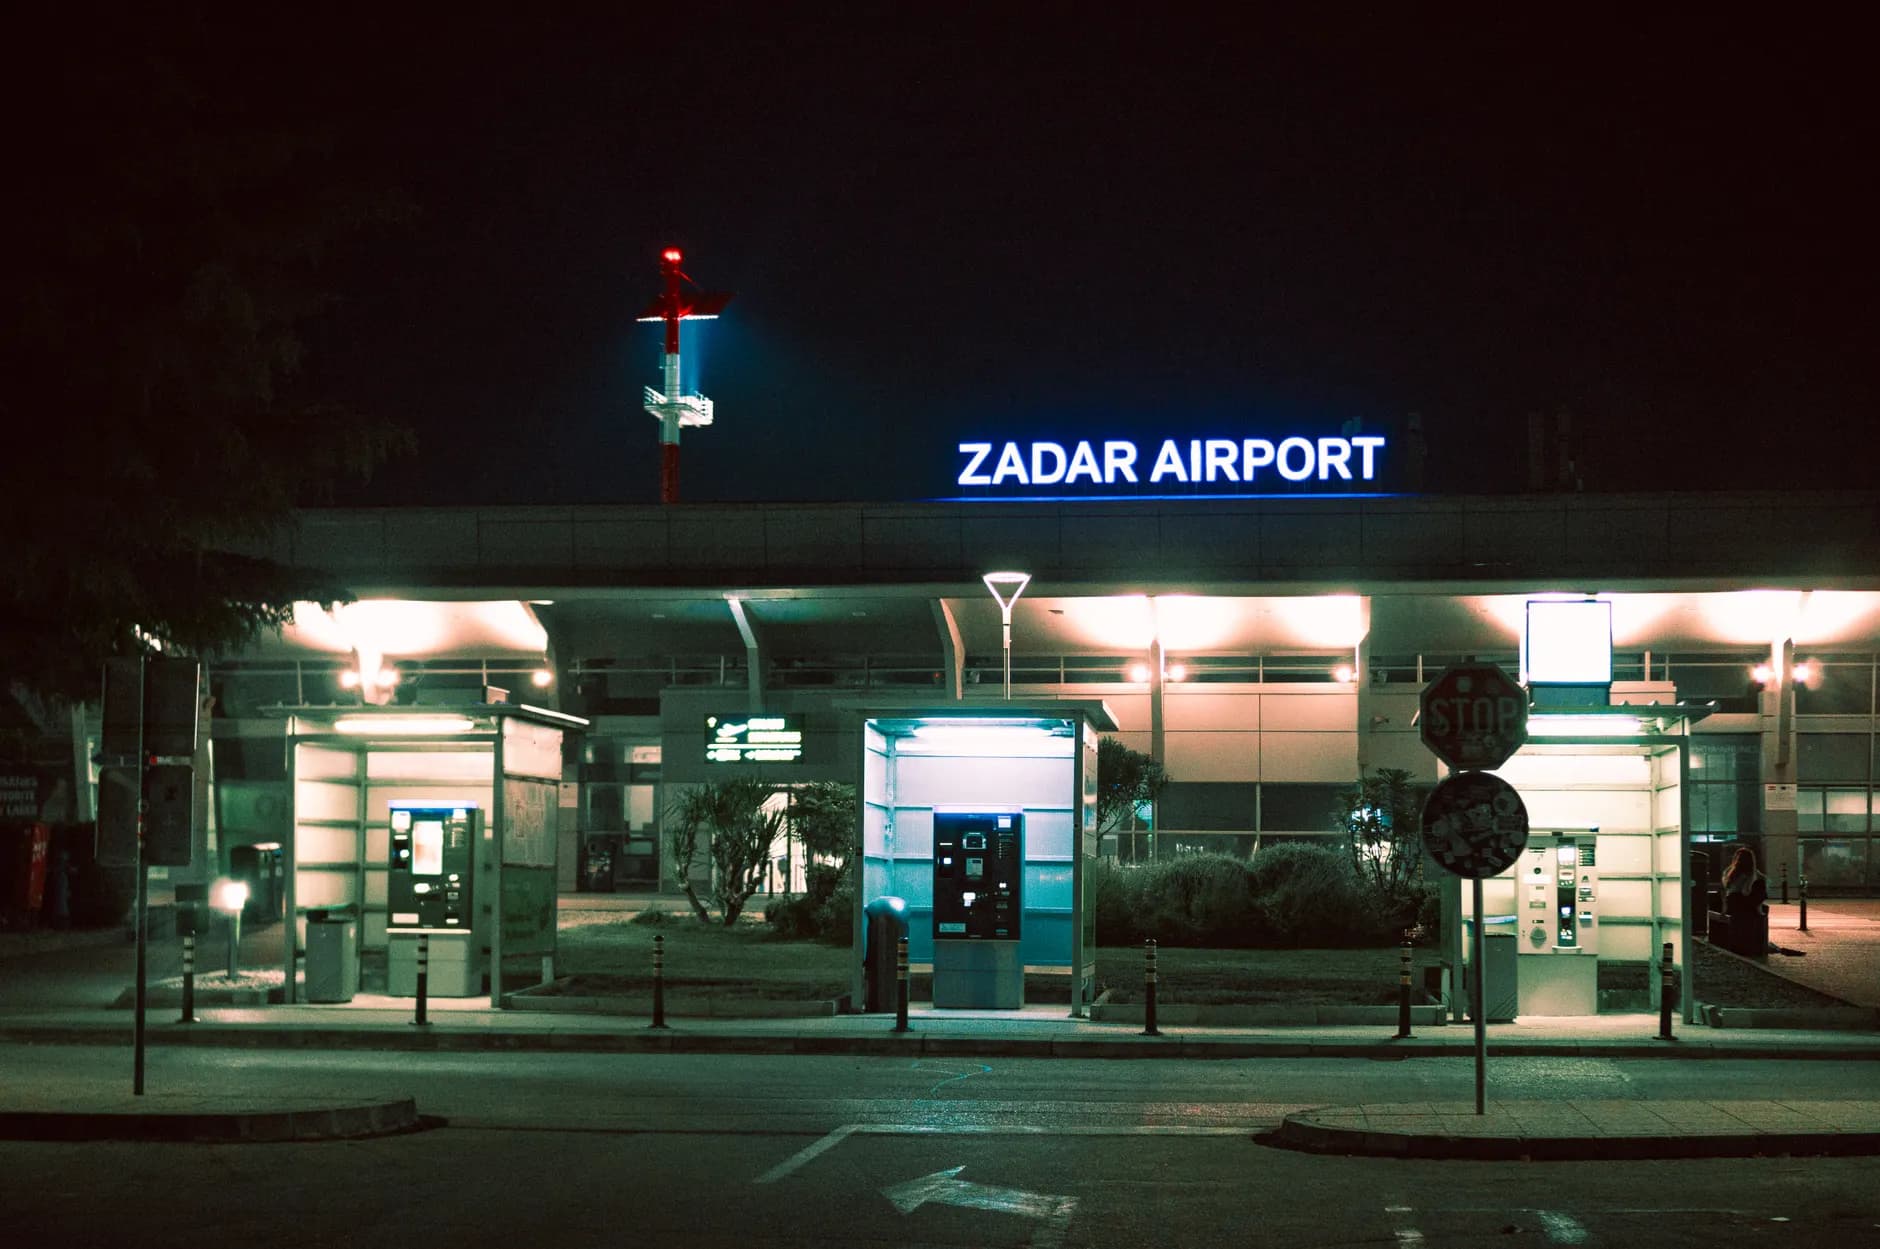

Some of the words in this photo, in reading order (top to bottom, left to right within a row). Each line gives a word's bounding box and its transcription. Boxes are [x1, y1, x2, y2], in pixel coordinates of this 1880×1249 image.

[957, 440, 1138, 485] ZADAR
[1149, 436, 1386, 483] AIRPORT
[1429, 696, 1519, 737] STOP
